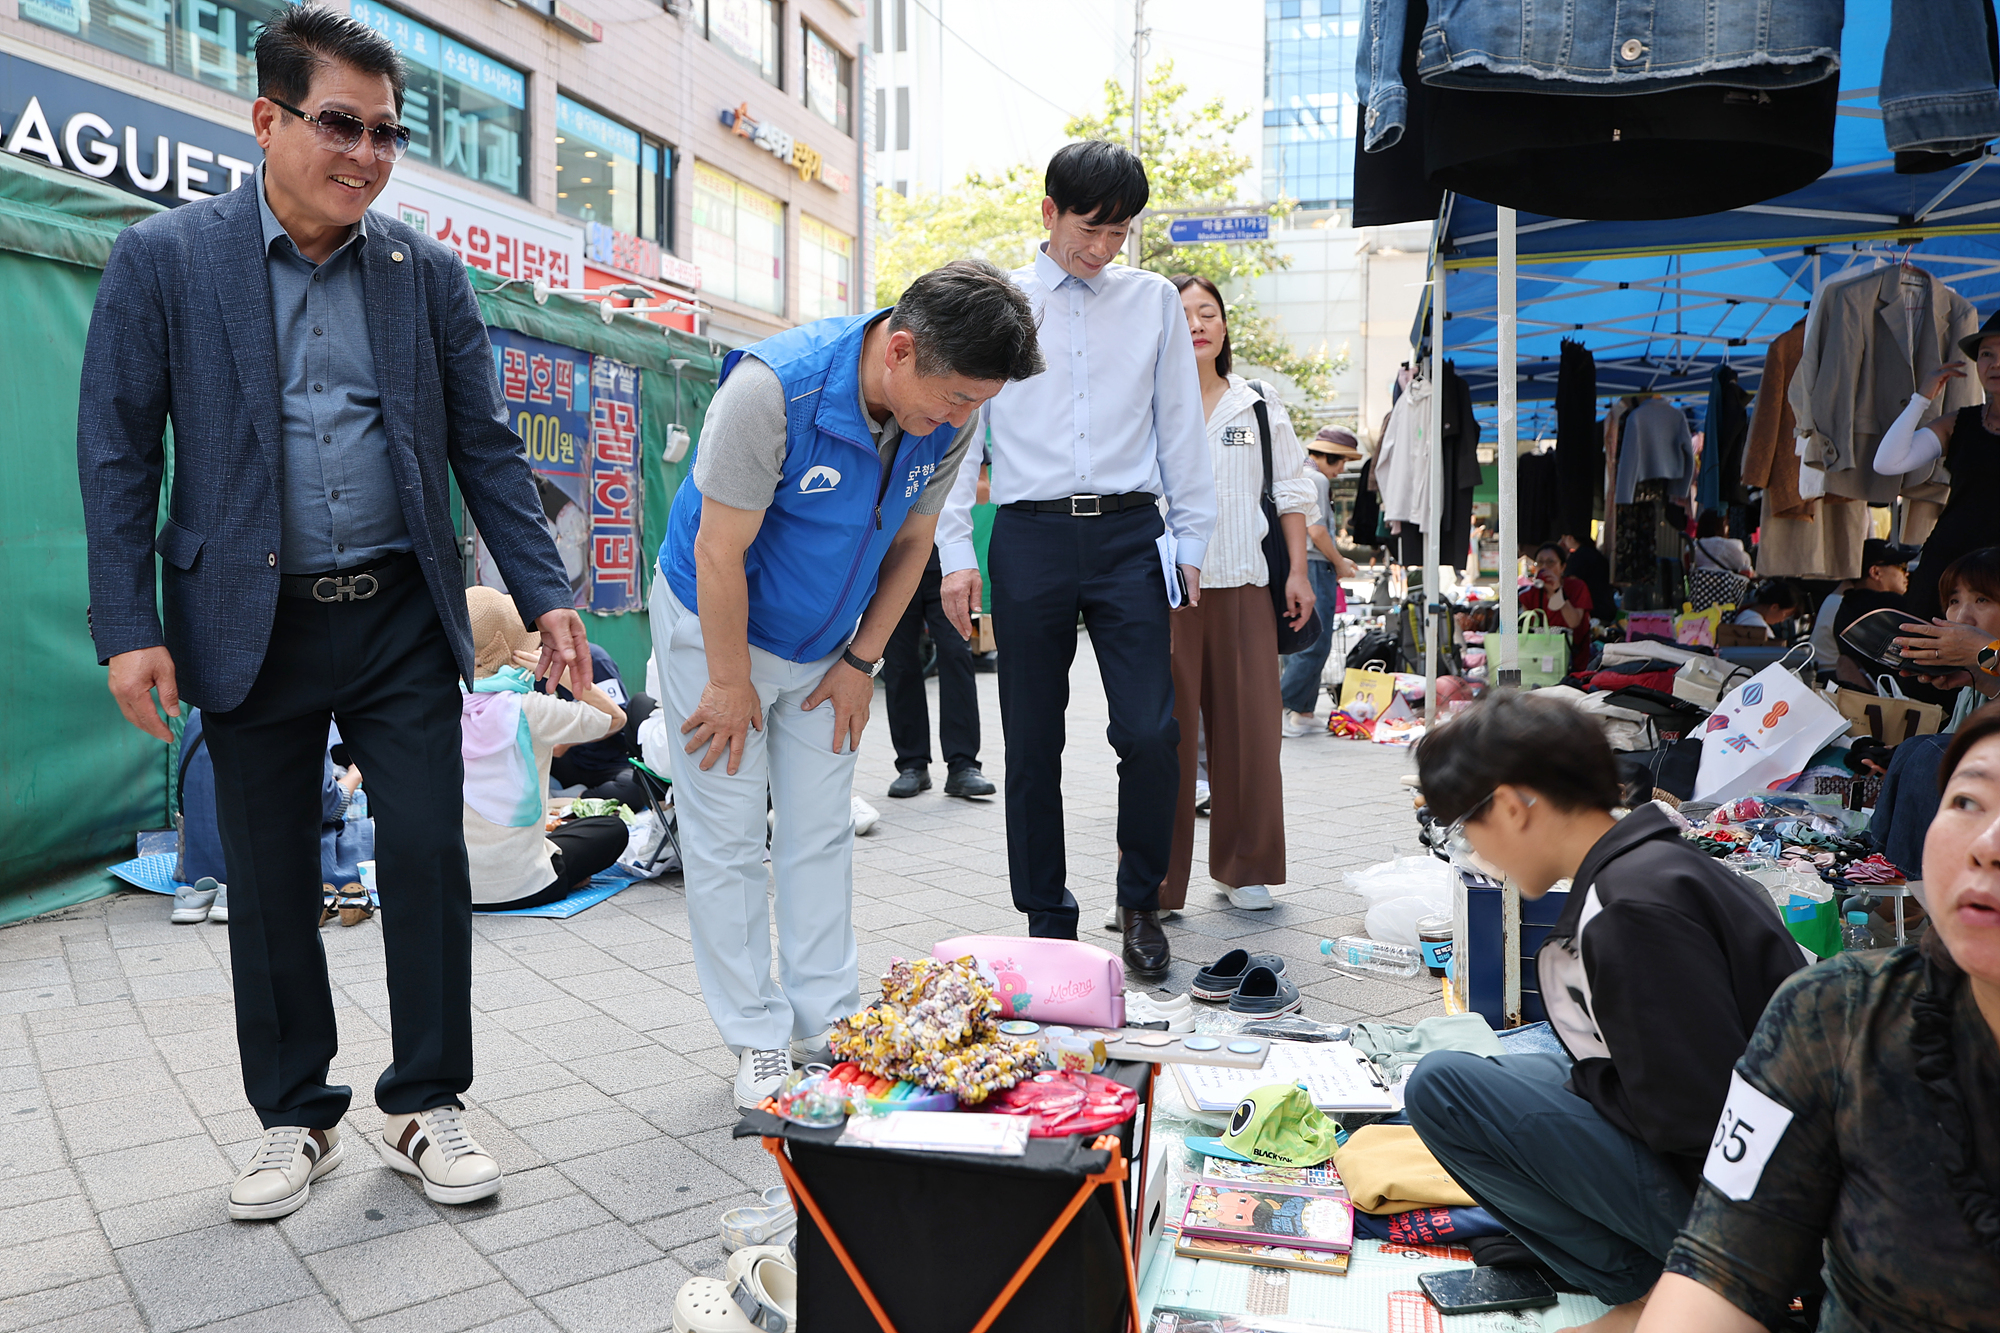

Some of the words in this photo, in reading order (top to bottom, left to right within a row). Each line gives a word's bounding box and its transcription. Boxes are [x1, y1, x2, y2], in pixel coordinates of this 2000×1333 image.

[444, 47, 480, 82] 수요일
[482, 65, 523, 100] 9시까지
[0, 95, 254, 201] AGUET
[754, 121, 795, 165] 스타키
[792, 139, 822, 183] 보청기
[1202, 218, 1267, 231] 마들로11가길
[504, 347, 573, 412] 꿀호떡
[508, 410, 574, 465] 000원
[594, 397, 637, 598] 꿀호떡
[1043, 978, 1096, 1005] Molang
[1714, 1107, 1755, 1164] 65
